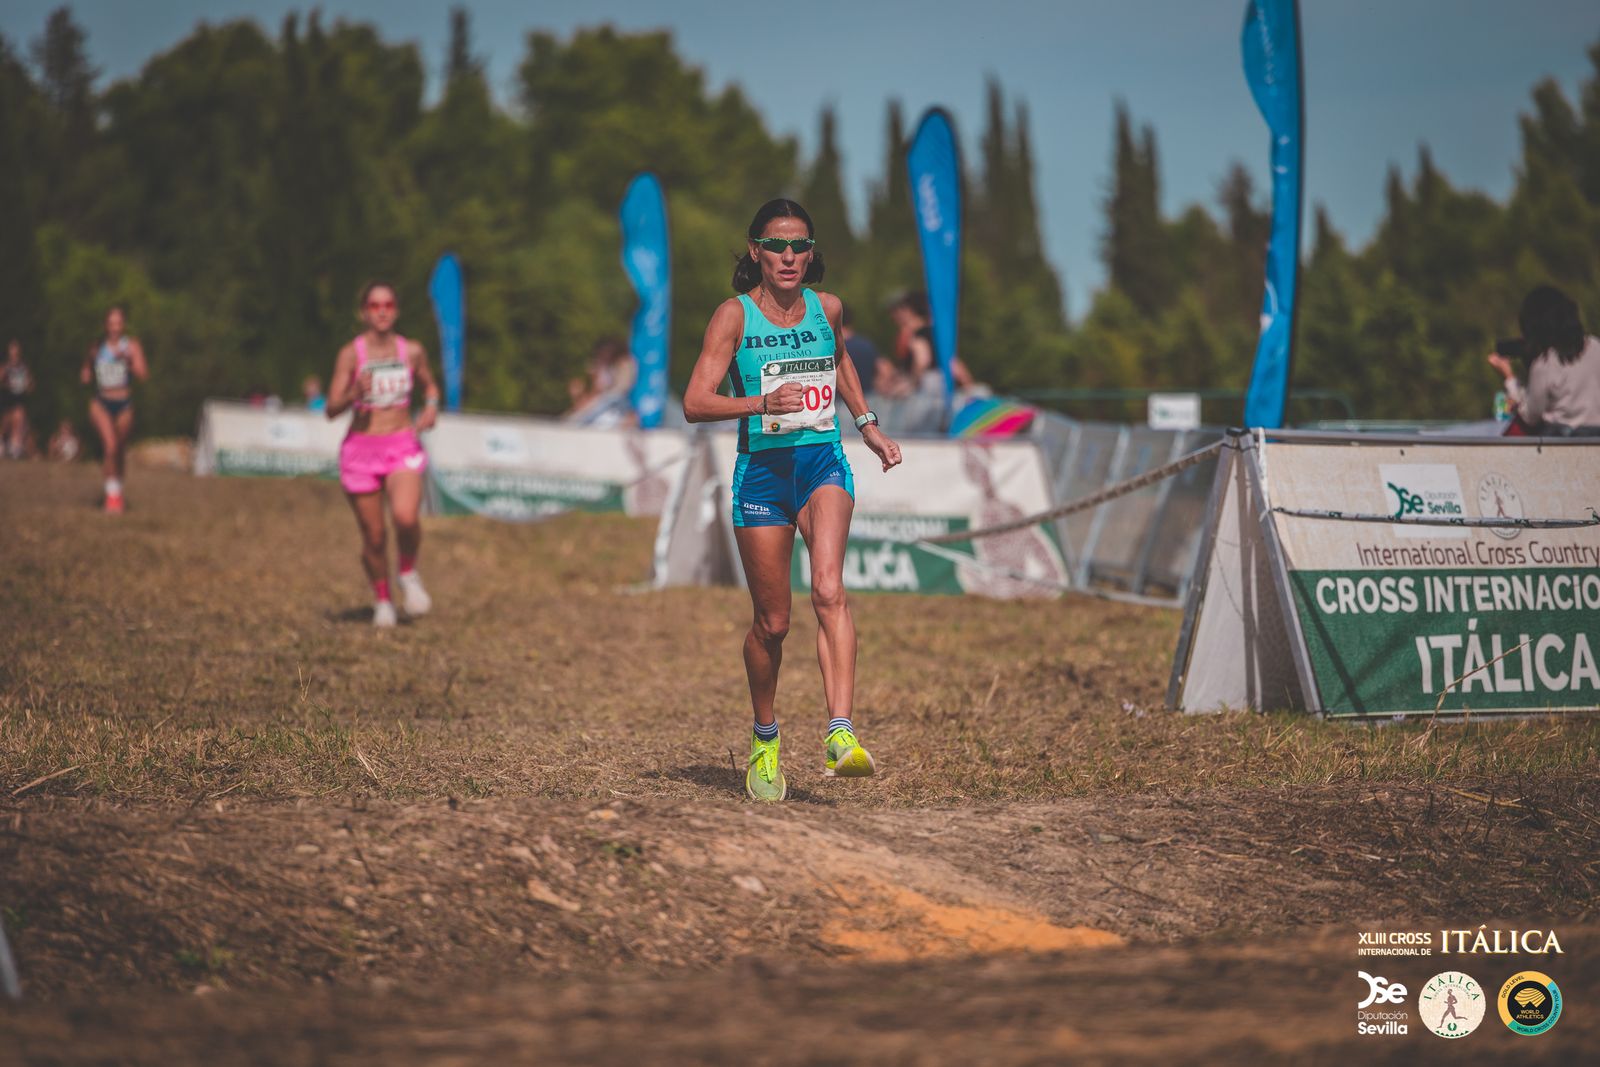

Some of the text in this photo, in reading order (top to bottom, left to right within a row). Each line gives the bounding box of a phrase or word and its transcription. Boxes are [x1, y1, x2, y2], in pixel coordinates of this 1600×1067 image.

[745, 329, 817, 349] nerja
[757, 349, 812, 362] ATLETISMO
[800, 385, 832, 411] 09
[1427, 501, 1463, 514] Sevilla
[1357, 541, 1600, 567] International Cross Country
[1316, 576, 1419, 615] CROSS
[1415, 618, 1600, 695] ITÁLICA
